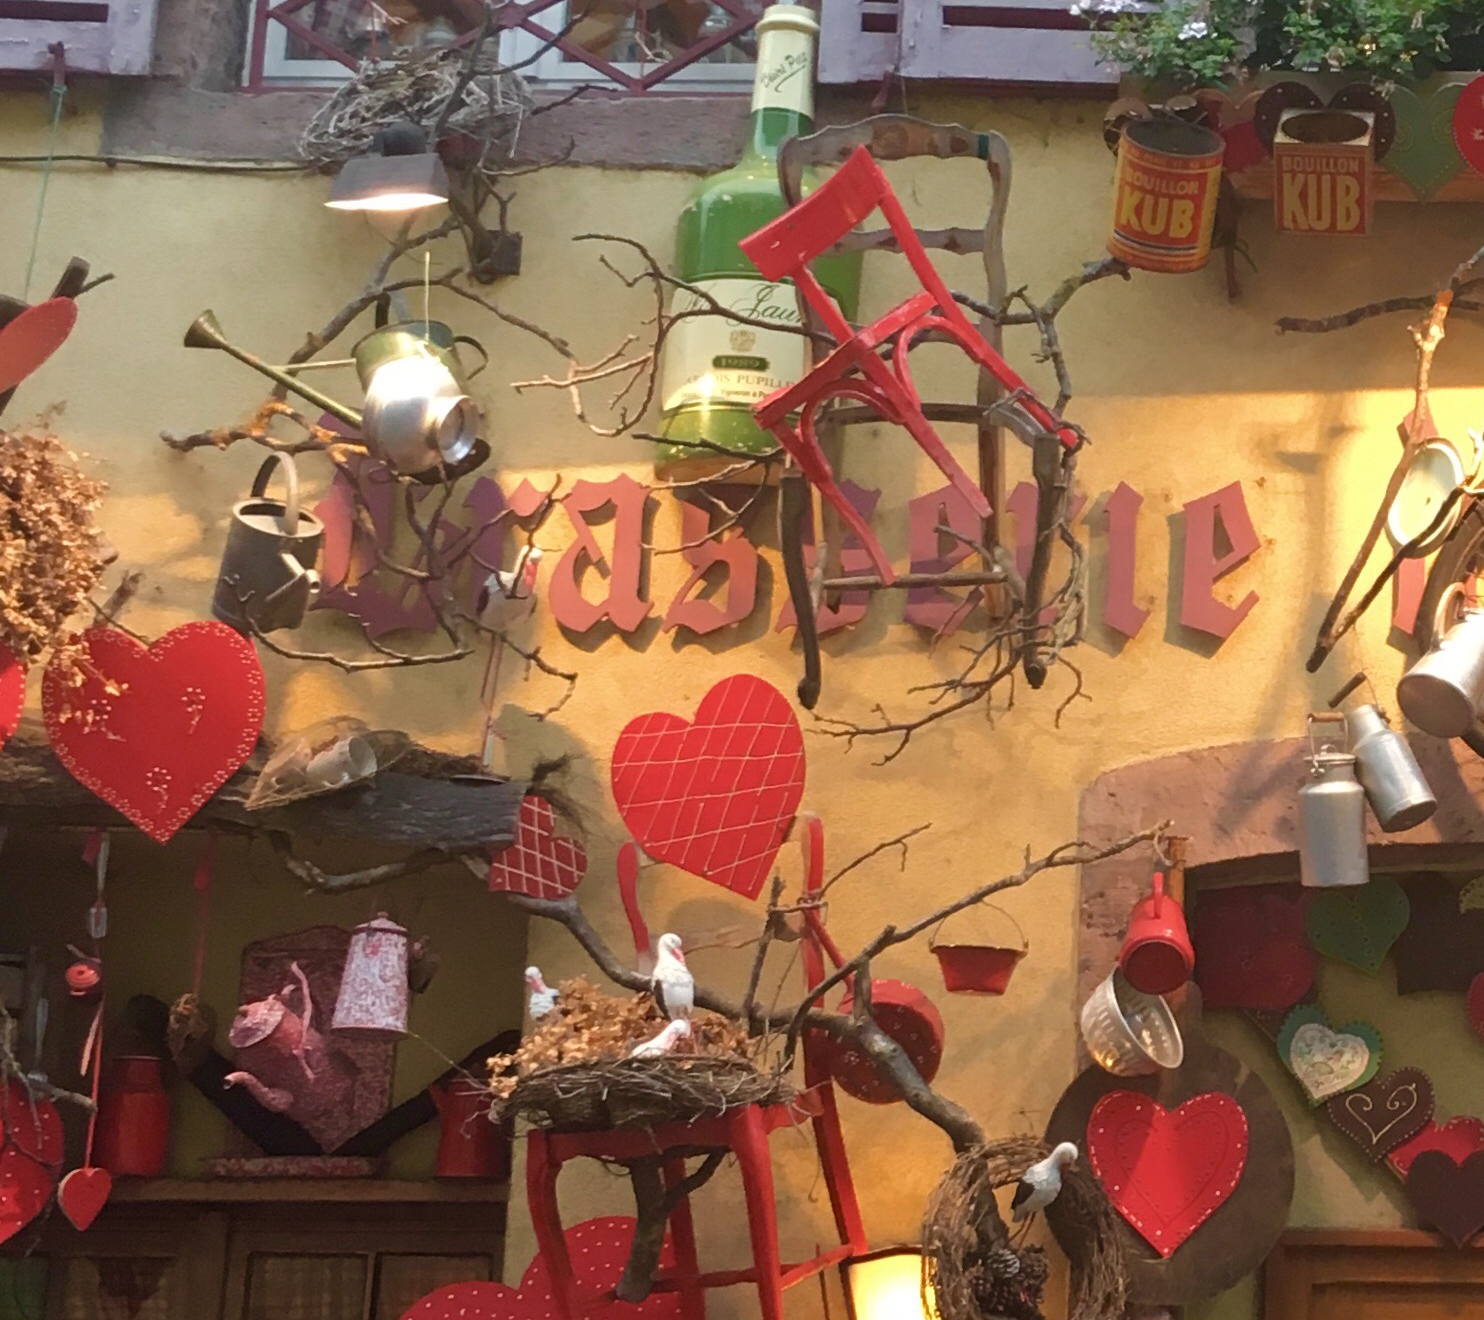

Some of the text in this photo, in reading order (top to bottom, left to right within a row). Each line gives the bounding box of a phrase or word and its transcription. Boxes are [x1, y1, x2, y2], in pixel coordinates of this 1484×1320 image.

[1281, 156, 1360, 173] BOUILLON
[1120, 186, 1195, 238] KUB
[1282, 173, 1360, 231] KUB
